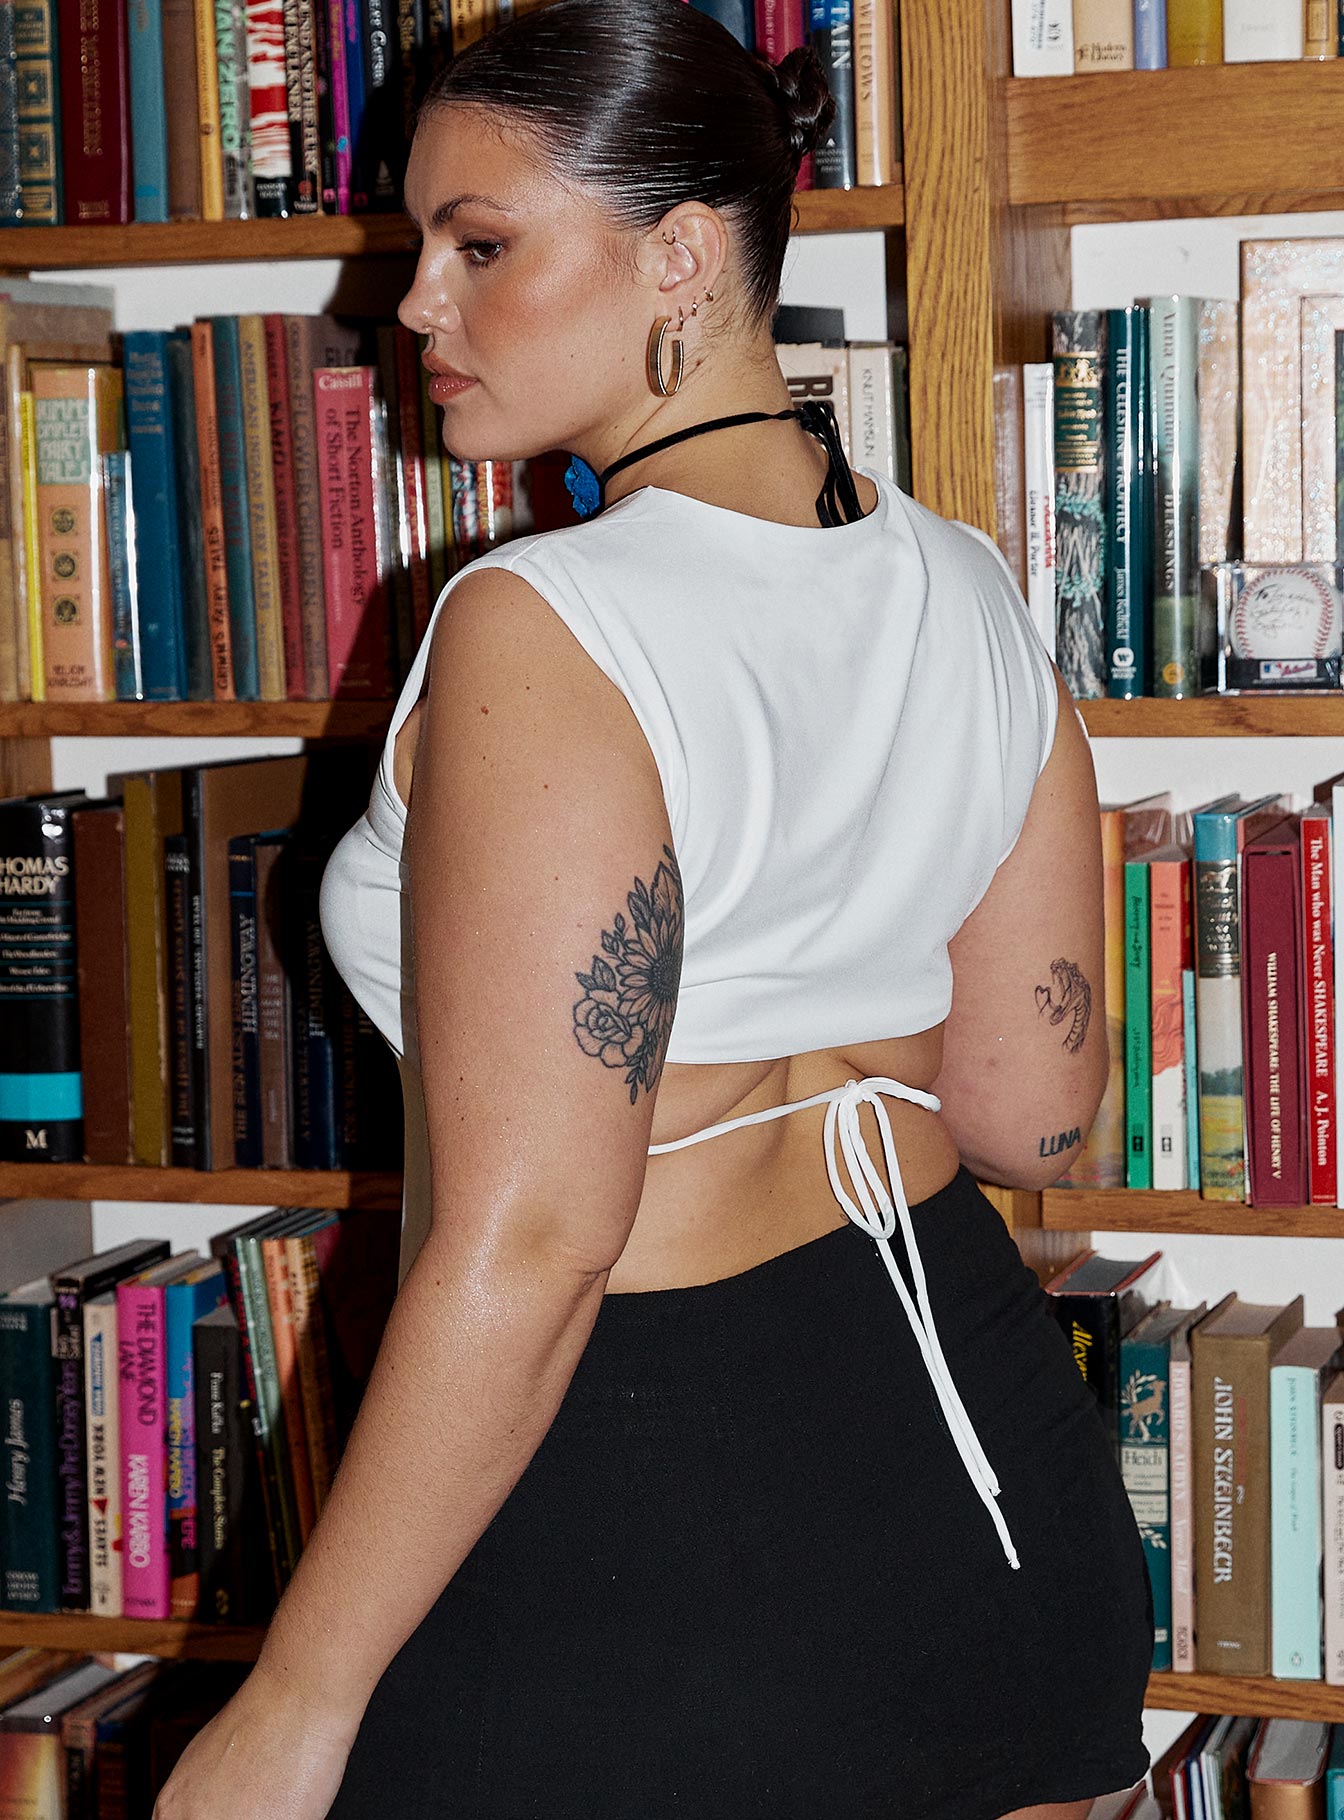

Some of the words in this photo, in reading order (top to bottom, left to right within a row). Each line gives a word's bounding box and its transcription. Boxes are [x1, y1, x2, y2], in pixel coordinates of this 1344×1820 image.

[287, 27, 303, 122] FAULKNER
[859, 2, 873, 101] WILLOWS
[218, 61, 241, 151] ZERO
[1163, 312, 1177, 358] Anna
[244, 340, 260, 429] AMERICAN
[1115, 346, 1131, 377] THE
[862, 368, 874, 402] KNUT
[326, 408, 343, 425] of
[344, 407, 361, 436] The
[862, 404, 876, 457] HAMSUN
[1115, 381, 1131, 459] CELESTINE
[247, 433, 263, 498] INDIAN
[292, 393, 312, 496] FLOWER
[326, 431, 344, 484] Short
[346, 442, 364, 512] Norton
[252, 502, 268, 553] FAIRY
[329, 487, 346, 549] Fiction
[1115, 465, 1130, 544] PROPHECY
[206, 526, 222, 572] TALES
[297, 500, 318, 608] CHILDREN
[348, 516, 369, 607] Anthology
[254, 559, 272, 612] TALES
[1113, 567, 1129, 597] James
[1115, 599, 1130, 640] Redfield
[1310, 836, 1324, 861] The
[1310, 862, 1323, 890] Man
[1311, 892, 1324, 918] who
[1312, 920, 1322, 943] was
[239, 913, 259, 1034] HEMINGWAY
[305, 918, 325, 1040] HEMINGWAY
[1266, 951, 1278, 998] WILLIAM
[1312, 944, 1325, 980] Never
[1313, 980, 1328, 1078] SHAKESPEARE
[233, 1073, 247, 1105] SUN
[1268, 1072, 1280, 1094] THE
[1315, 1089, 1328, 1105] A.
[234, 1109, 248, 1140] THE
[1269, 1096, 1281, 1118] LIFE
[1270, 1118, 1281, 1135] OF
[1313, 1105, 1329, 1117] J.
[26, 1129, 48, 1150] M
[1040, 1126, 1081, 1158] LUNA
[1270, 1135, 1282, 1169] HENRY
[1316, 1119, 1330, 1166] Pointon
[1271, 1170, 1282, 1180] V
[135, 1301, 157, 1334] THE
[118, 1340, 136, 1382] LANE
[135, 1336, 158, 1427] DIAMOND
[1172, 1367, 1187, 1430] EDWARD
[1213, 1375, 1234, 1441] JOHN
[4, 1398, 30, 1450] James
[5, 1450, 31, 1506] Henry
[1124, 1450, 1163, 1466] Heidi
[127, 1453, 149, 1510] KAREN
[209, 1468, 225, 1513] Complete
[213, 1514, 227, 1550] Stories
[1213, 1446, 1234, 1585] STEINBECK
[127, 1510, 151, 1569] KARBO
